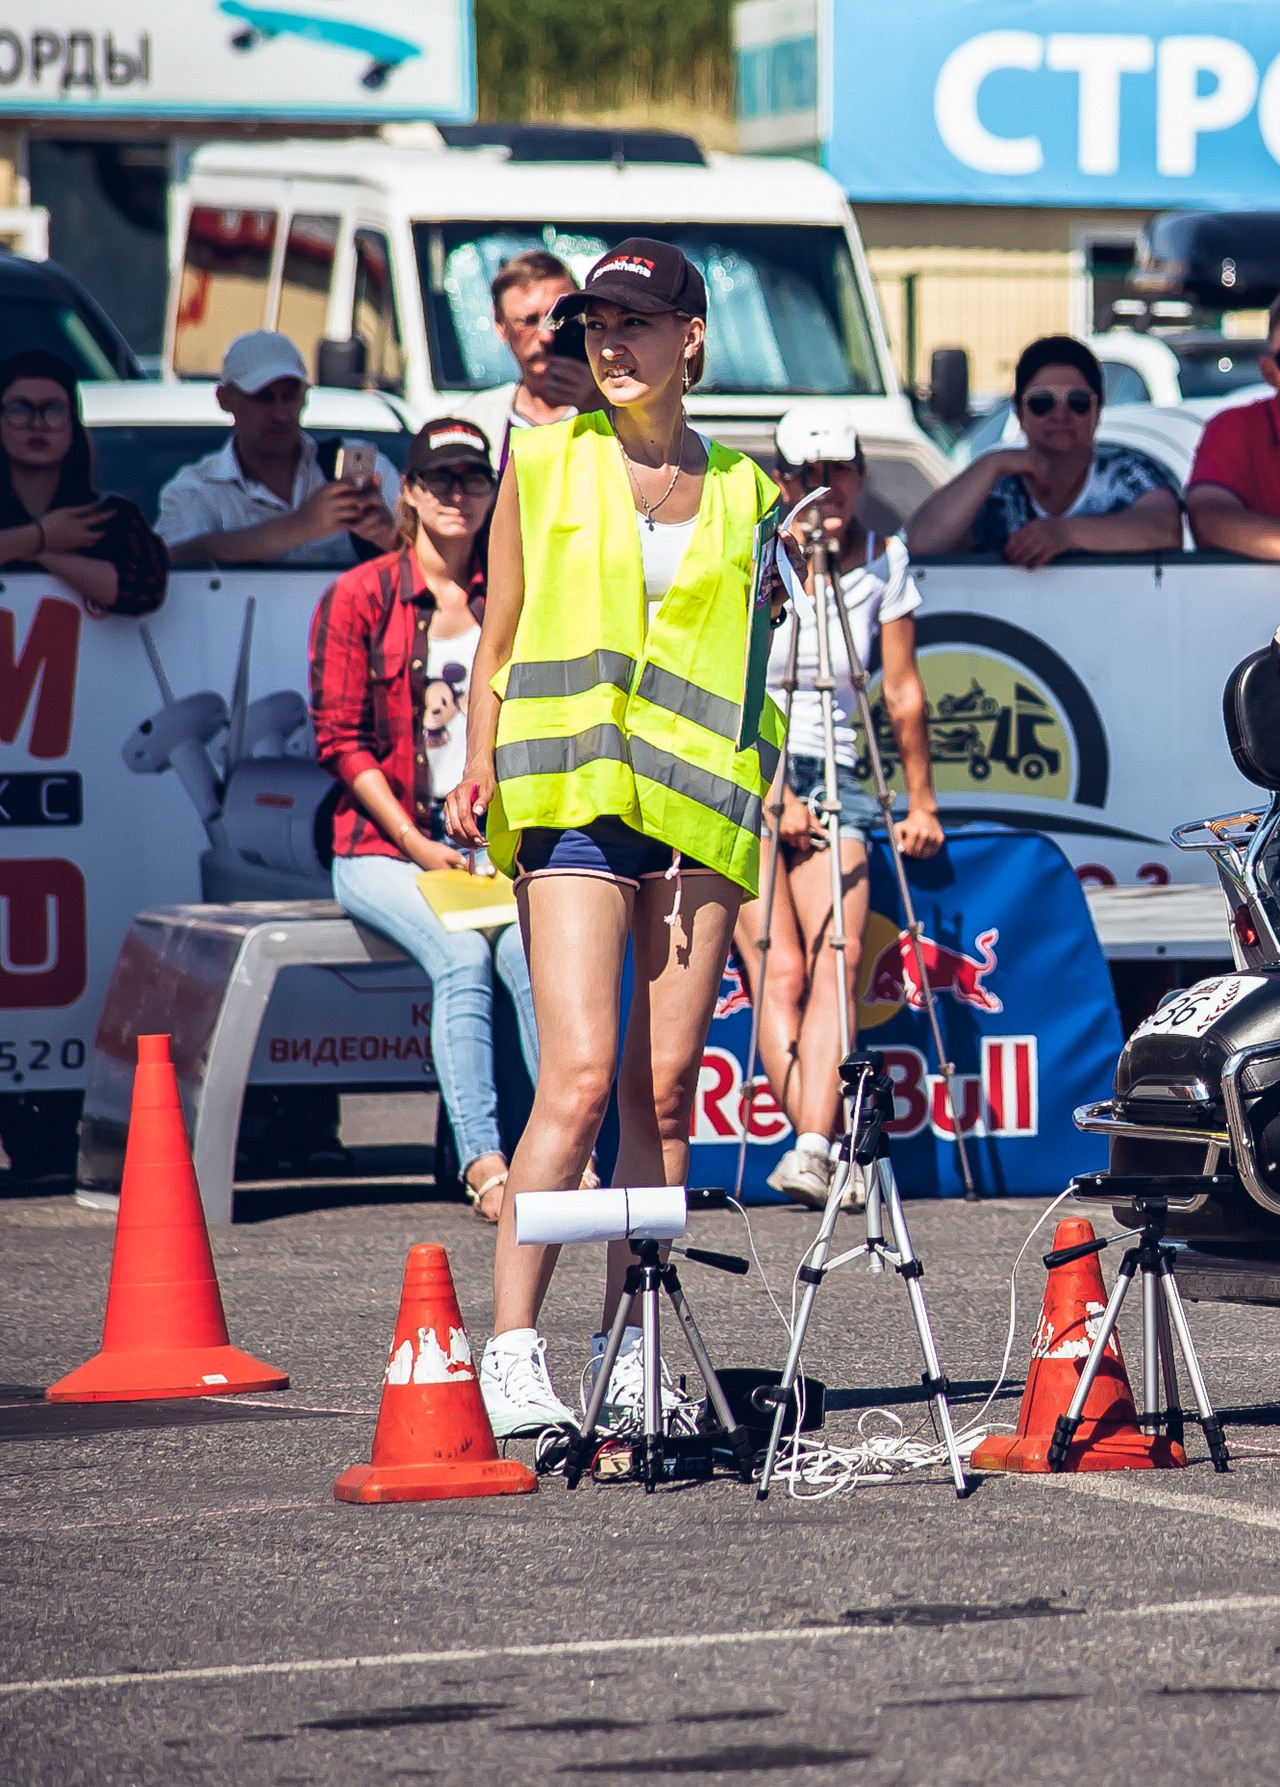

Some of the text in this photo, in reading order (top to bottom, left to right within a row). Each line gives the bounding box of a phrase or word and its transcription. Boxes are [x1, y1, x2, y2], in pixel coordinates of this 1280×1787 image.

[1152, 996, 1211, 1027] 36
[268, 1036, 432, 1067] ВИДЕОНА
[833, 1043, 1032, 1139] Bull
